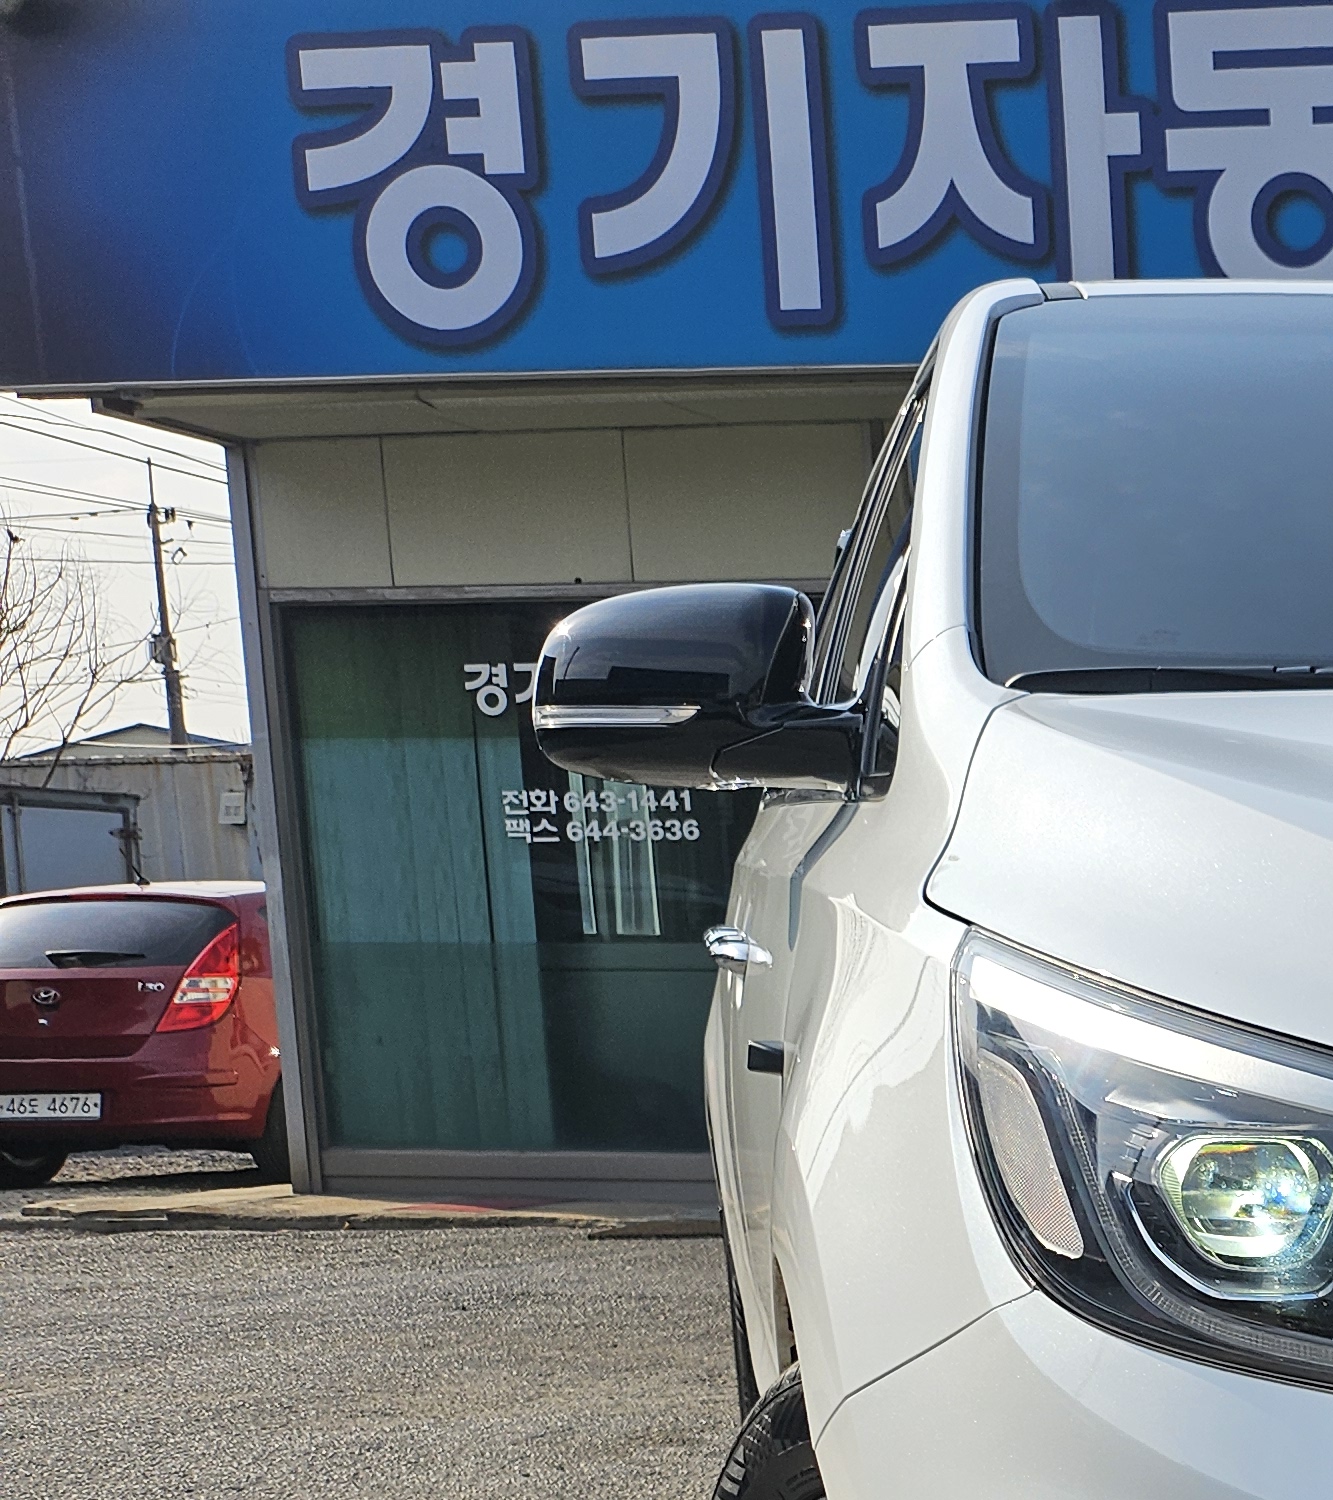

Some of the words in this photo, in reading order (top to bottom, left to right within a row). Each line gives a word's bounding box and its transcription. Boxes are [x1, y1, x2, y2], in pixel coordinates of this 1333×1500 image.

[502, 789, 559, 815] 전화
[563, 789, 692, 813] 643-1441
[504, 818, 561, 844] 팩스
[566, 818, 700, 842] 644-3636
[6, 1097, 39, 1114] 46도
[47, 1096, 91, 1114] 4676
